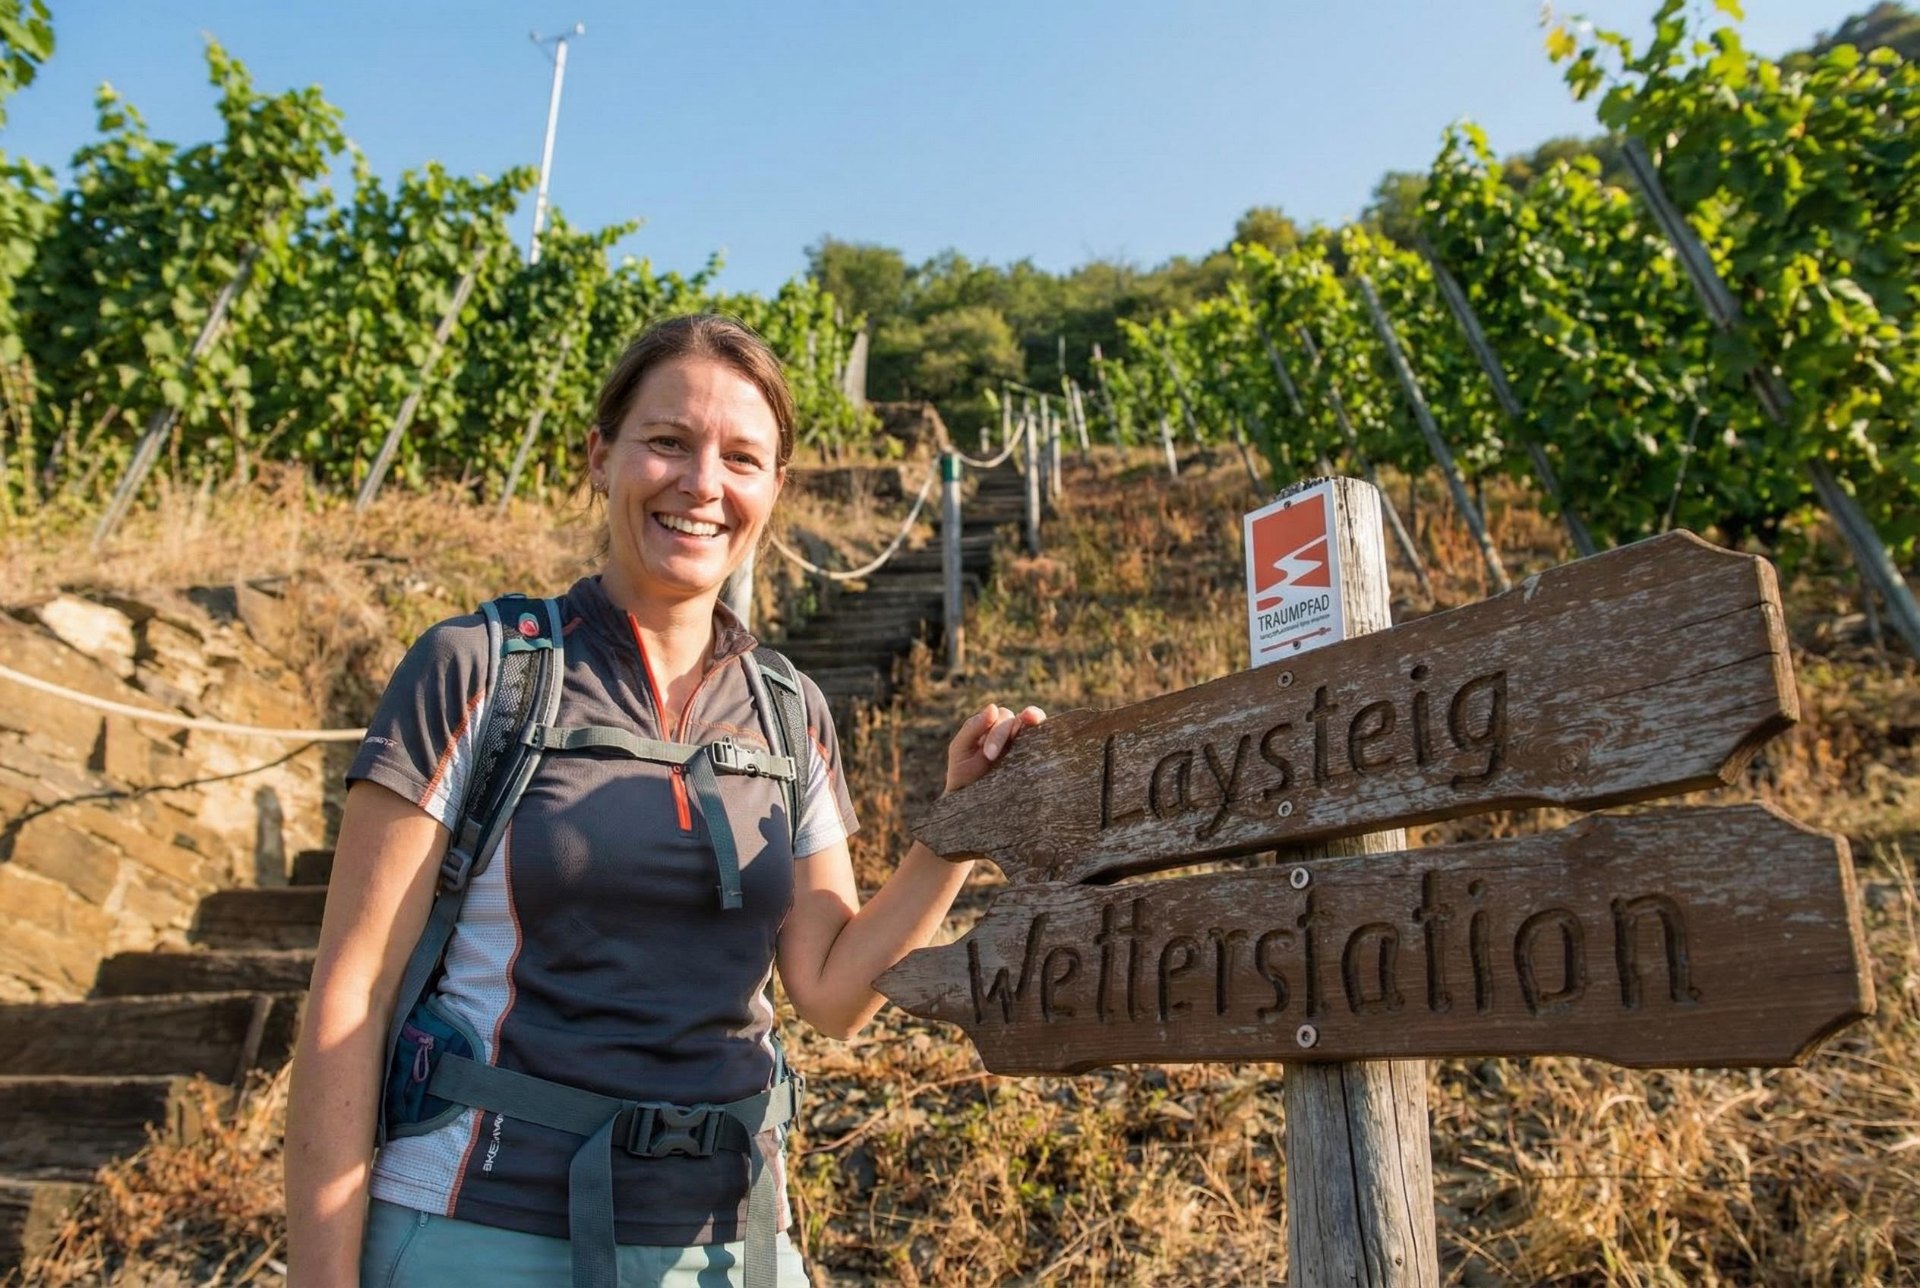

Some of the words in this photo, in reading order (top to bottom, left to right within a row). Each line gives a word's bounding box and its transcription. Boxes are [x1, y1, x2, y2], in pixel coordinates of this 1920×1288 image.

[1257, 594, 1330, 632] TRAUMPFAD
[1101, 664, 1508, 841] Laysteig
[966, 868, 1702, 1024] Wetterstation
